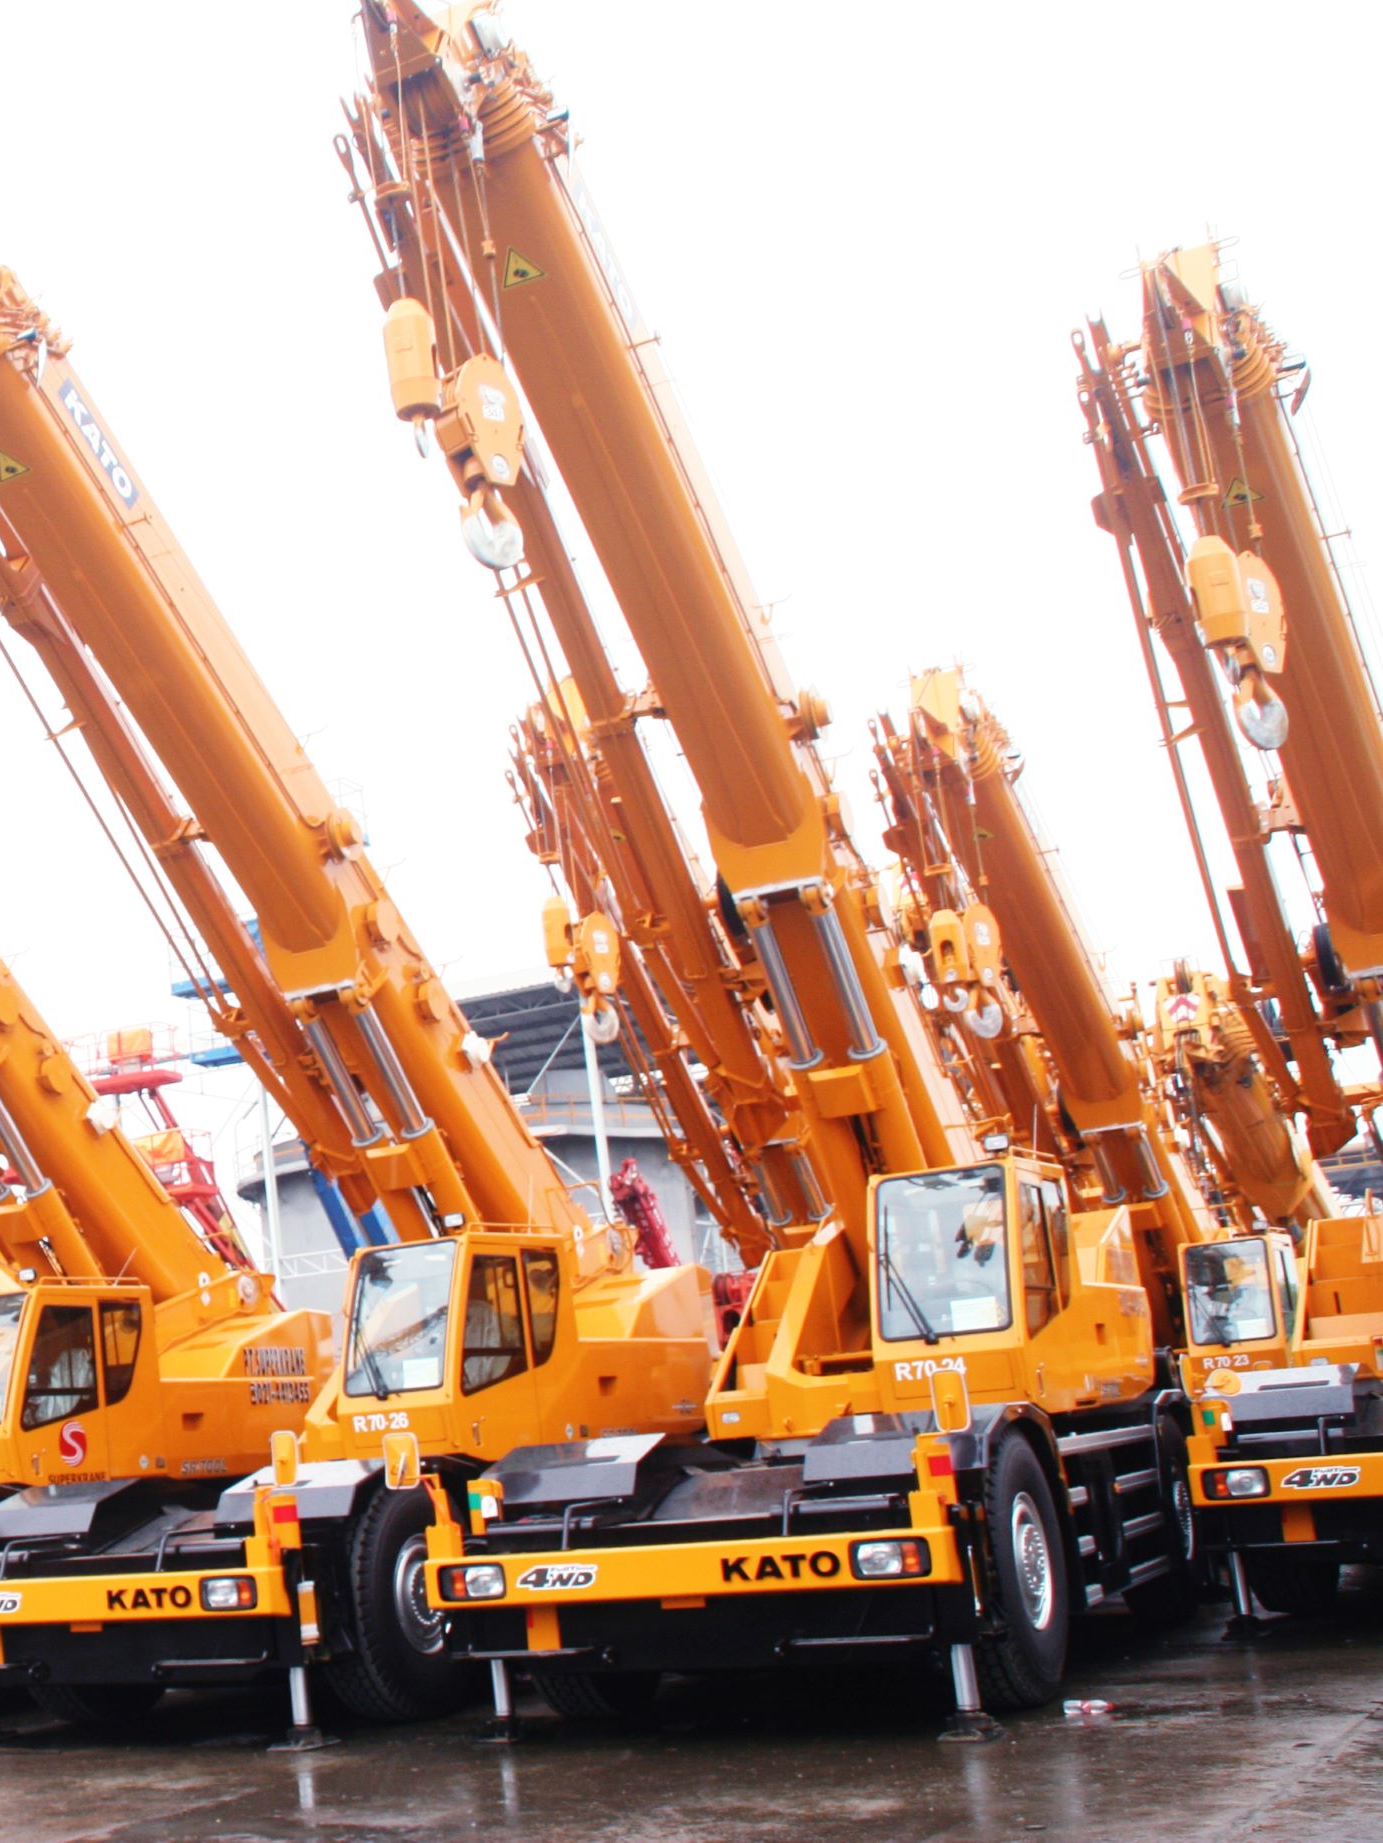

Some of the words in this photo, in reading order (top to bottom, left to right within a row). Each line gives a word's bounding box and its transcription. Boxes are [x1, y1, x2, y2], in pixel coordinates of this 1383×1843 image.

[64, 389, 132, 499] KATO
[352, 1411, 410, 1433] R70-26
[1283, 1469, 1359, 1488] 4WD
[519, 1567, 595, 1588] 4WD
[720, 1550, 842, 1583] KATO
[106, 1585, 193, 1611] KATO
